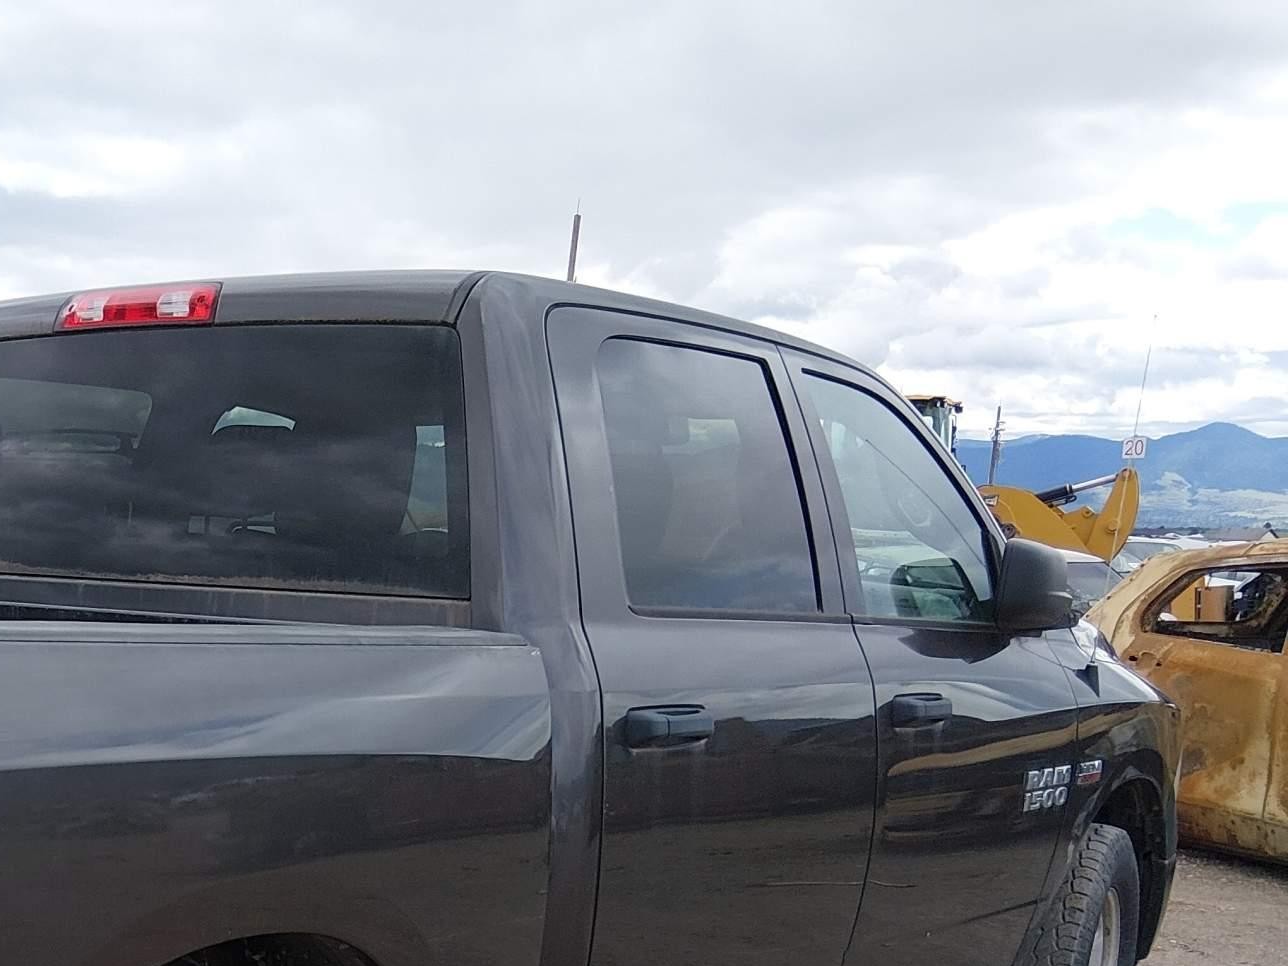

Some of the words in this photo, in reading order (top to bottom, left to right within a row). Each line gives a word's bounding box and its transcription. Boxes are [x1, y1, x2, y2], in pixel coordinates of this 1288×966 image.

[1124, 439, 1144, 456] 20
[1026, 765, 1071, 790] RAM
[1023, 786, 1068, 812] 1500
